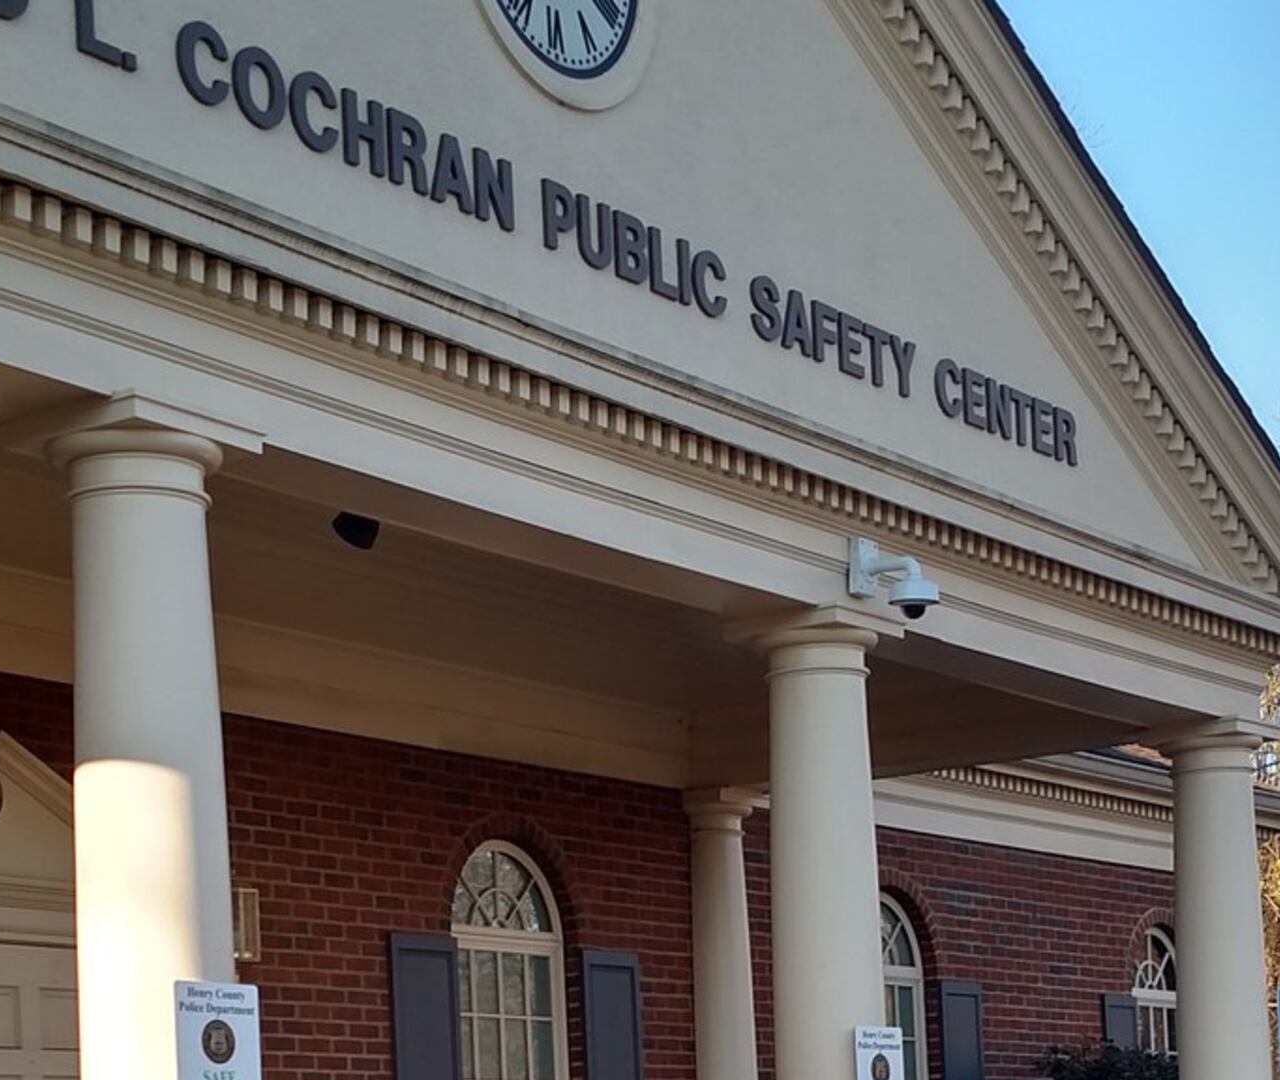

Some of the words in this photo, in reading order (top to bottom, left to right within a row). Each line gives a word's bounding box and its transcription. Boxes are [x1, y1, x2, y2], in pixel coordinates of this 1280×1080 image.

[175, 20, 515, 232] COCHRAN
[540, 176, 728, 318] PUBLIC
[750, 275, 917, 397] SAFETY
[933, 357, 1078, 466] CENTER
[187, 986, 213, 1000] Henry
[215, 988, 245, 1003] County
[179, 1001, 204, 1013] Police
[206, 1003, 255, 1016] Department
